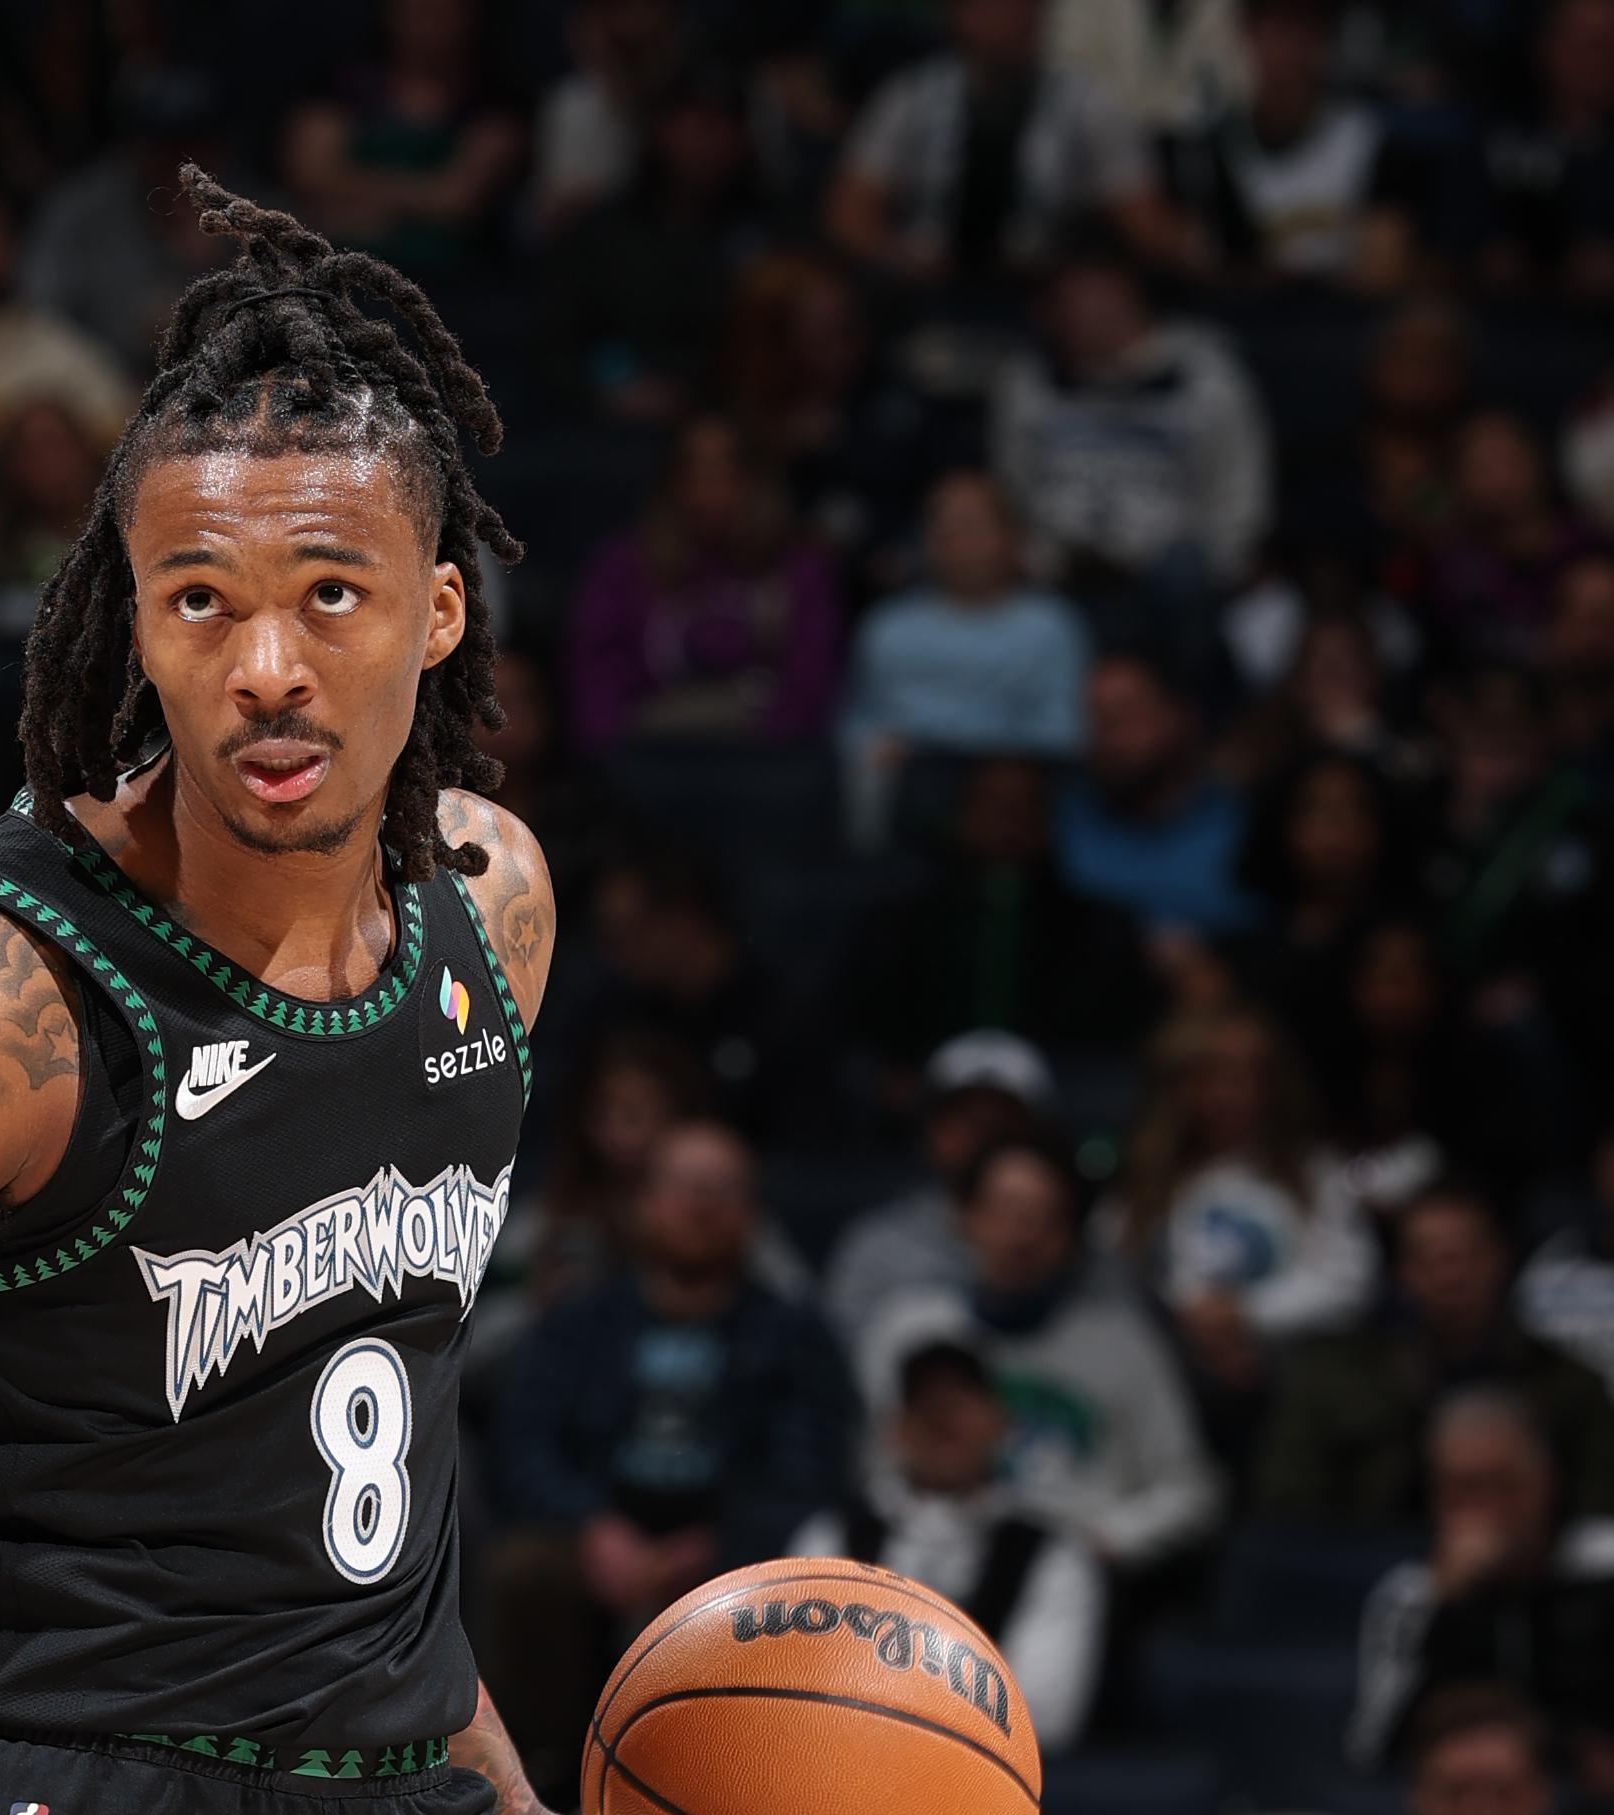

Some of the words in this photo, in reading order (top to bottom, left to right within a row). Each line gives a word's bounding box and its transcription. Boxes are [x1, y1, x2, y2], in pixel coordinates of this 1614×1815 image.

[189, 1041, 249, 1088] NIKE
[424, 1028, 507, 1084] sezzle
[310, 1337, 413, 1585] 8
[729, 1599, 1011, 1740] Wilson
